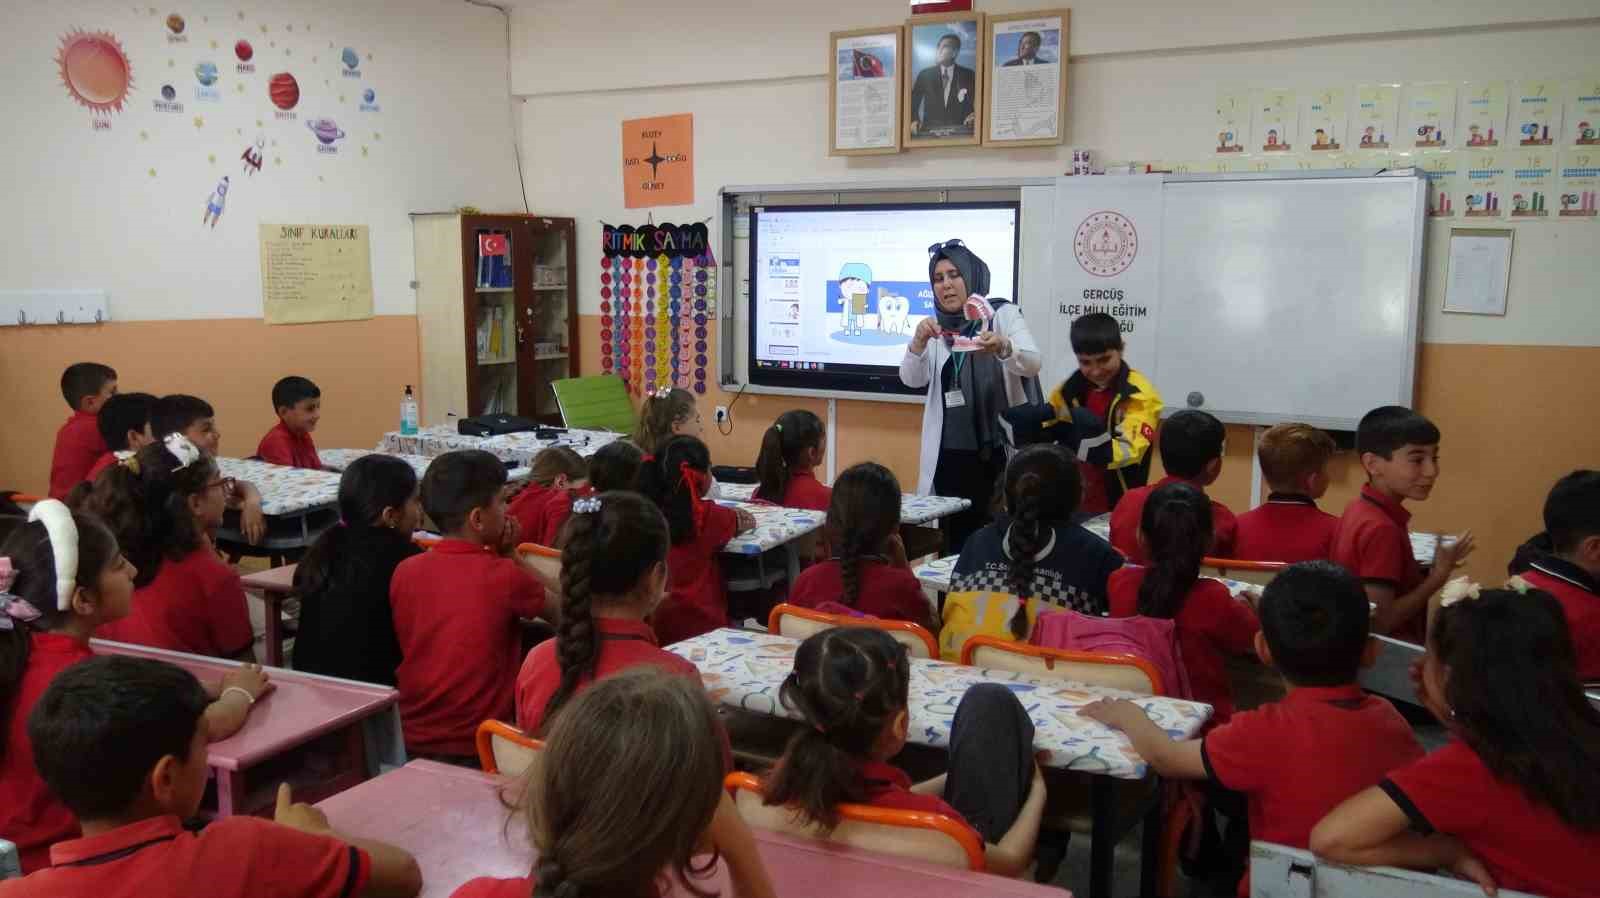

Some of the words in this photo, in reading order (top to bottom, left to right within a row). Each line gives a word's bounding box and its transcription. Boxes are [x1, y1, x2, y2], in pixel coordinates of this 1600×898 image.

[1083, 288, 1124, 302] GERCÜŞ
[1059, 302, 1081, 316] İLÇE
[1112, 303, 1147, 317] EĞİTİM
